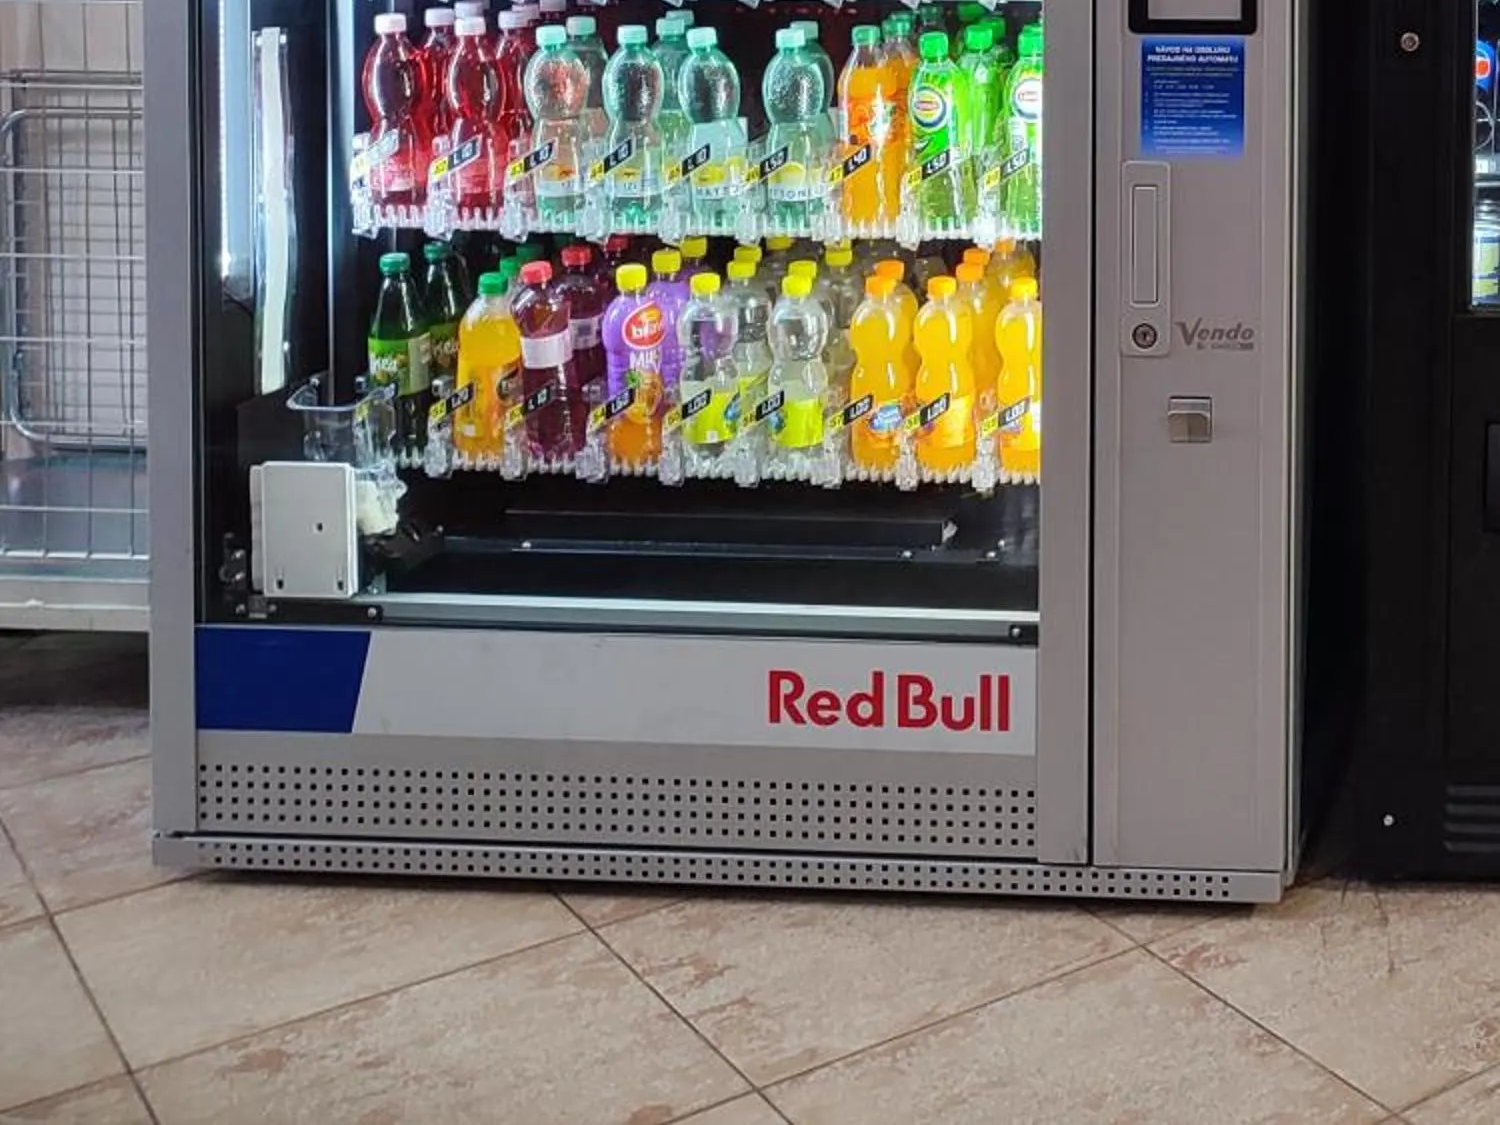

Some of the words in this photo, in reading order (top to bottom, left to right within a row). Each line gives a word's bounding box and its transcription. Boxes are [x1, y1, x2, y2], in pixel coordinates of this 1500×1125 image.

[1174, 317, 1255, 346] Vendo
[767, 669, 884, 727] Red
[896, 675, 1011, 732] Bull
